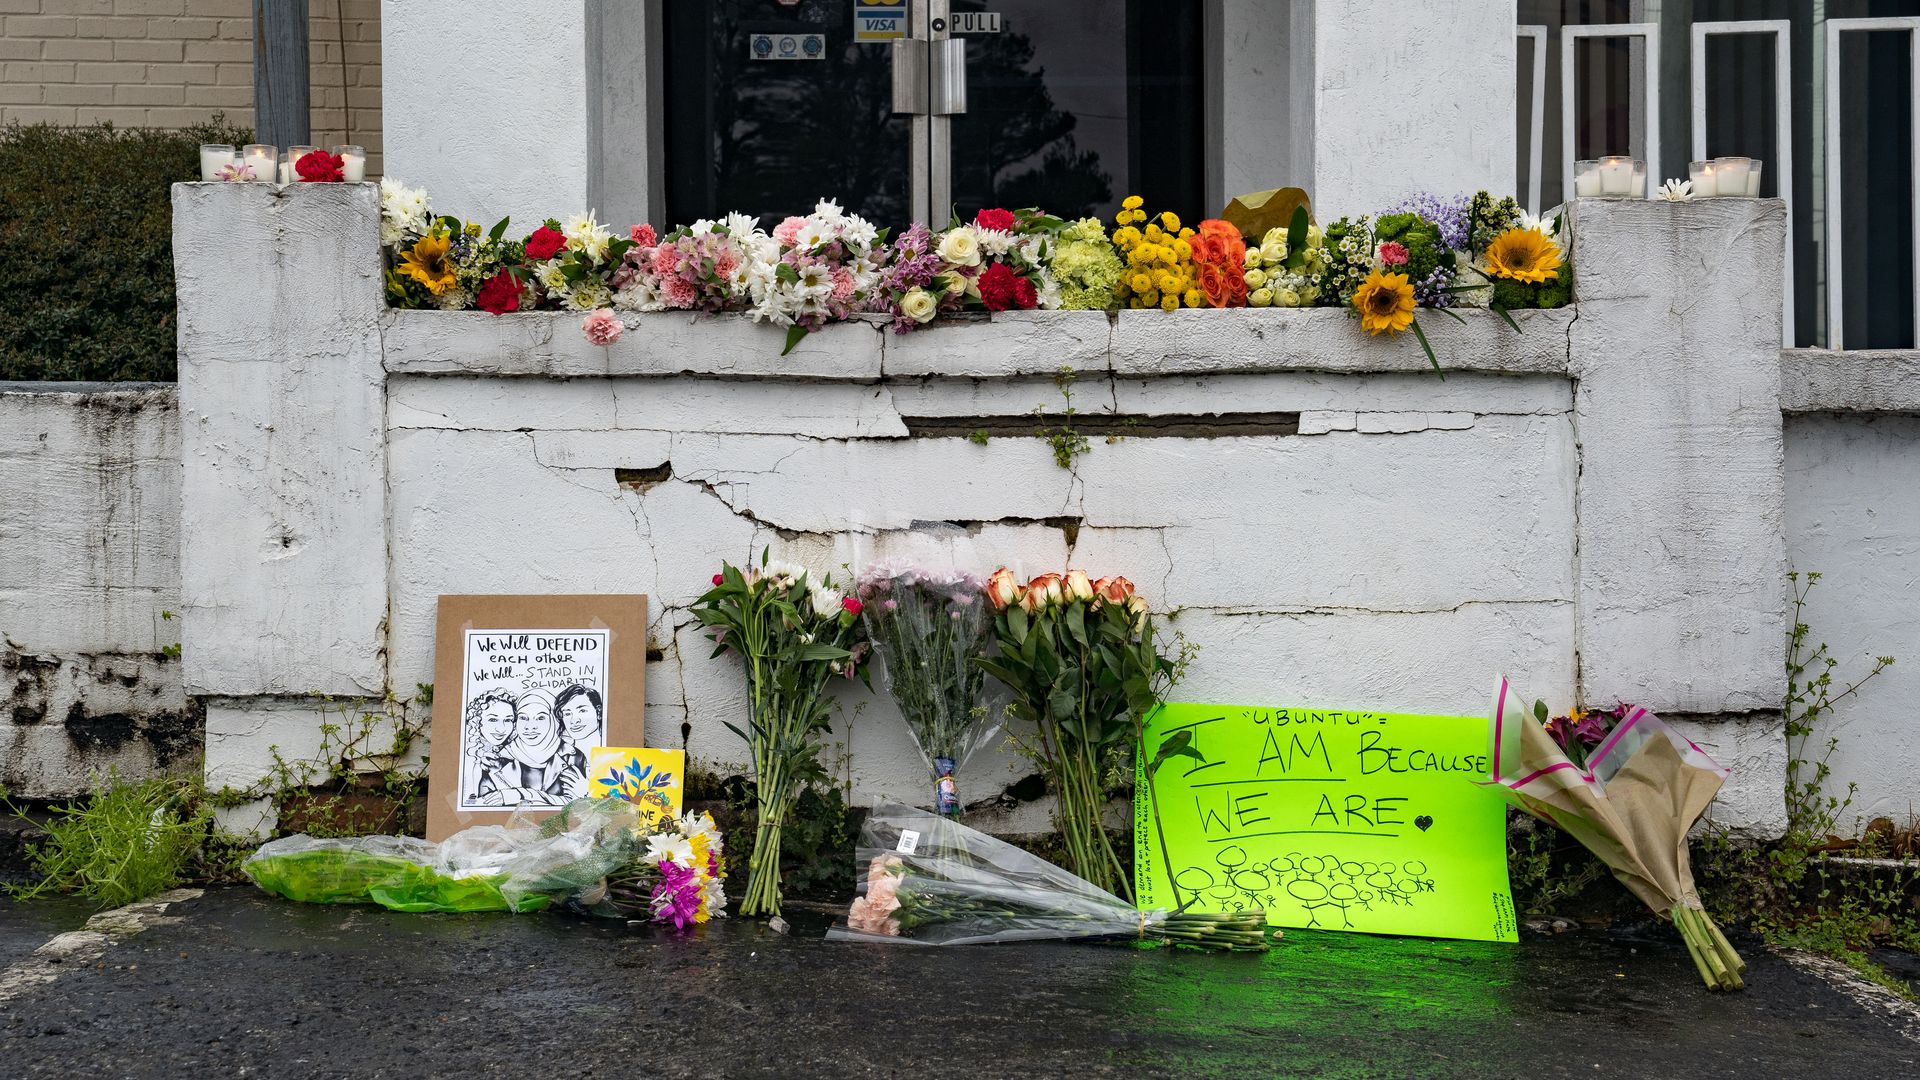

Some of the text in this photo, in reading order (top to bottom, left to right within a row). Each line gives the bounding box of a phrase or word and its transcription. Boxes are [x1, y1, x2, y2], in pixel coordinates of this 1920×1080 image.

[866, 19, 896, 31] VISA
[952, 14, 998, 31] PULL
[477, 637, 497, 652] We
[499, 635, 531, 650] Will
[473, 669, 489, 681] We
[525, 666, 572, 679] STAND
[579, 664, 595, 676] IN
[521, 676, 597, 690] SOLIDARITY
[1160, 717, 1487, 778] I AM BECAUSE
[1195, 790, 1409, 834] WE ARE
